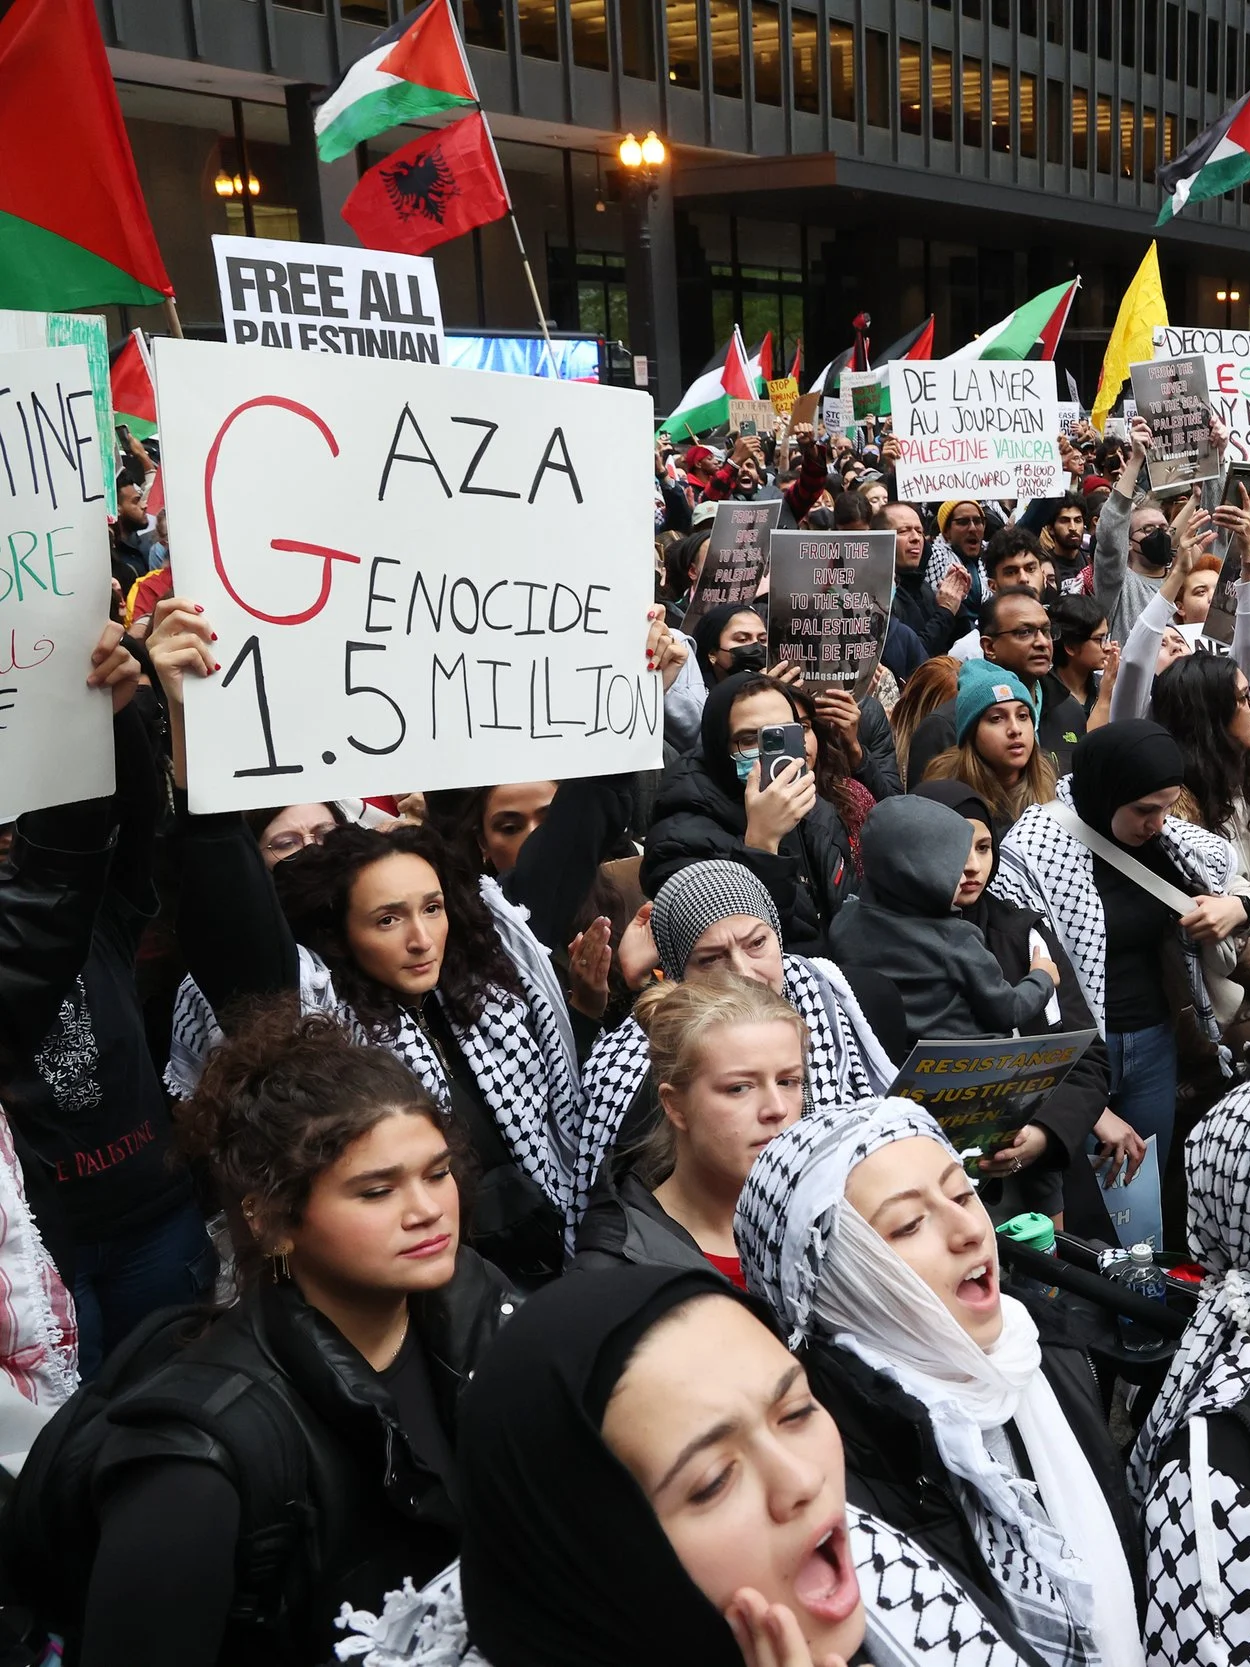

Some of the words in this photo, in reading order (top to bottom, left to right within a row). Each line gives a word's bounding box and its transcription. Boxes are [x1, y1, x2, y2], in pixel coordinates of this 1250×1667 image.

[226, 256, 348, 319] FREE
[360, 269, 435, 326] ALL
[233, 319, 440, 365] PALESTINIAN
[770, 379, 790, 392] STOP
[903, 368, 936, 403] DE
[953, 369, 982, 401] LA
[989, 368, 1040, 402] MER
[910, 408, 939, 436] AU
[949, 406, 1044, 434] JOURDAIN
[1154, 412, 1202, 431] PALESTINE
[900, 437, 988, 464] PALESTINE
[992, 439, 1054, 460] VAINCRA
[1014, 463, 1056, 477] #BLOOD
[901, 470, 1011, 499] #MACRONCOWARD
[800, 543, 839, 559] FROM
[844, 543, 869, 558] THE
[813, 568, 855, 584] RIVER
[790, 593, 808, 609] TO
[813, 593, 839, 609] THE
[843, 593, 874, 610] SEA,
[791, 617, 871, 636] PALESTINE
[779, 643, 817, 661] WILL
[822, 644, 841, 661] BE
[845, 641, 877, 659] FREE
[221, 635, 406, 778] 1.5
[432, 653, 658, 740] MILLION
[915, 1046, 1078, 1074] RESISTANCE
[900, 1088, 926, 1103] IS
[931, 1076, 1056, 1103] JUSTIFIED
[75, 1120, 156, 1177] PALESTINE
